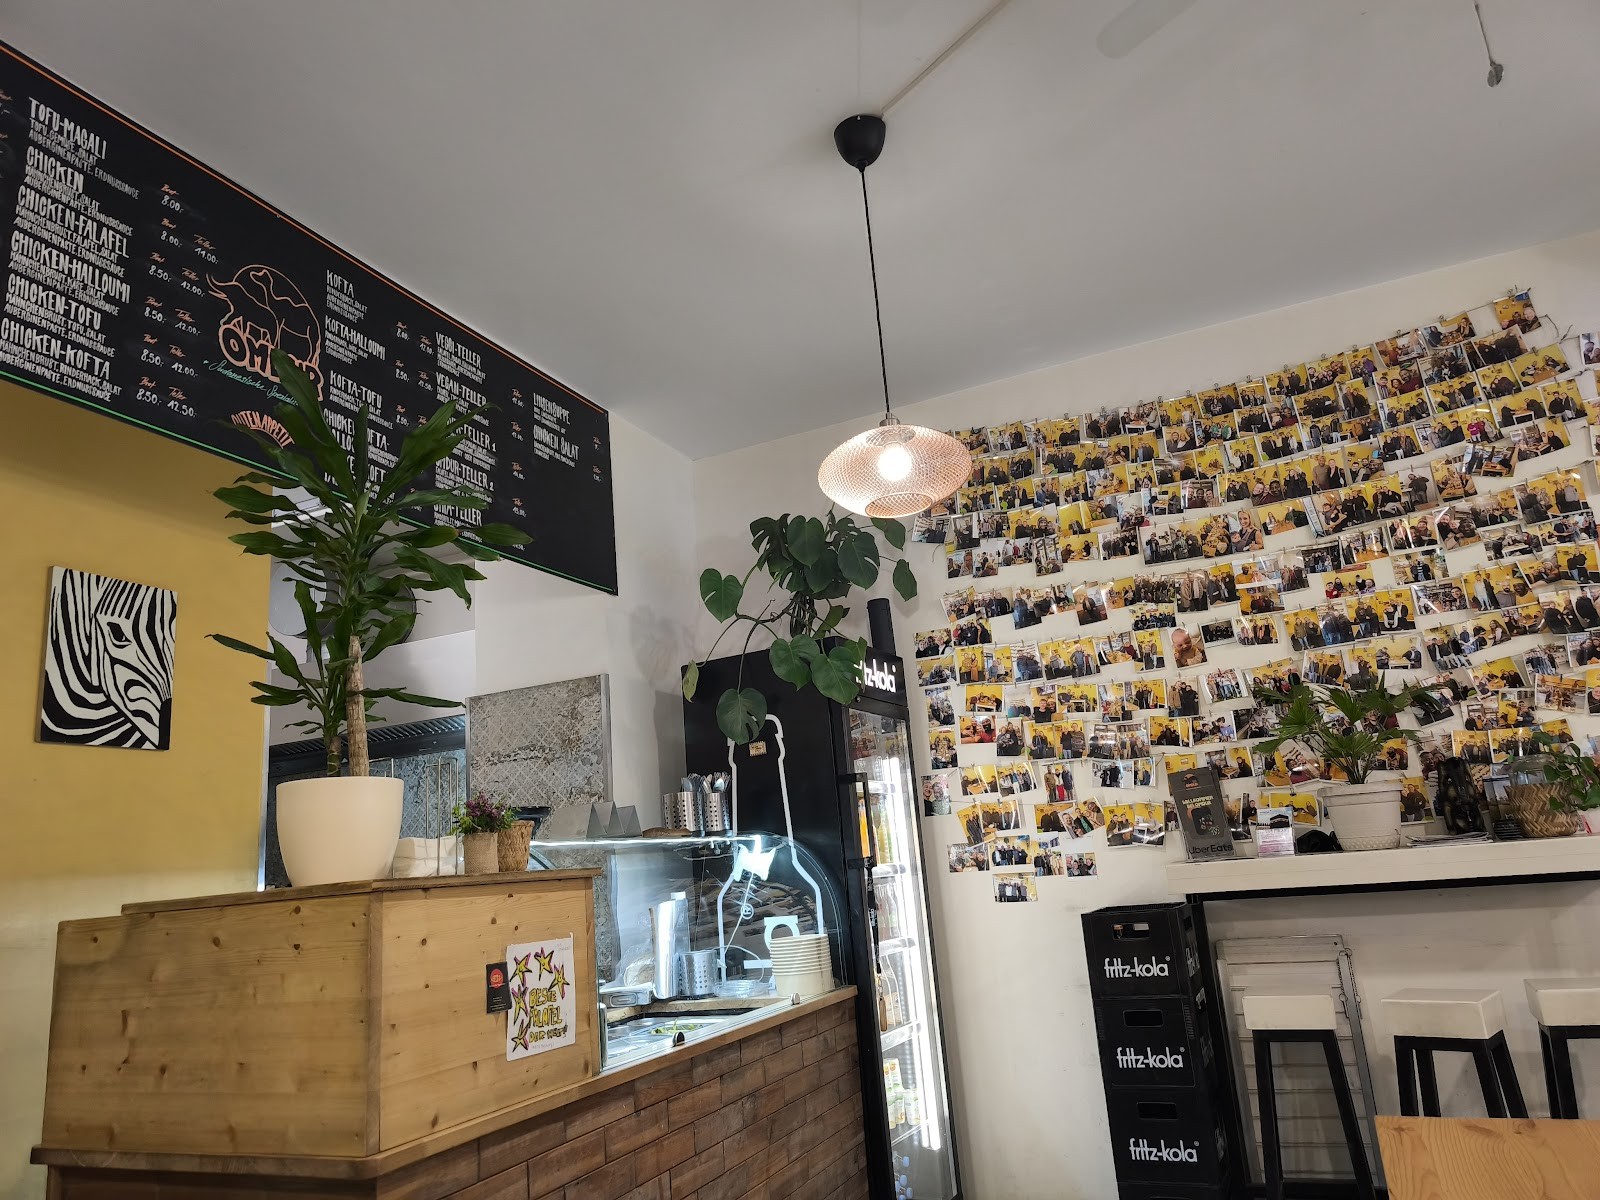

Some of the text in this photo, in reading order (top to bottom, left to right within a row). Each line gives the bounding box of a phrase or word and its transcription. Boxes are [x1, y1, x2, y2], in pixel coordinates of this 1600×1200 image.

[28, 96, 107, 161] TOFU-MAGALI
[26, 146, 84, 194] CHICKEN
[17, 185, 129, 258] CHICKEN-FALAFEL
[11, 230, 131, 304] CHICKEN-HALLOUMI
[326, 269, 355, 299] KOFTA
[8, 273, 101, 330] CHICKEN-TOFU
[0, 317, 110, 381] CHICKEN-KOFTA
[325, 315, 386, 361] KOFTA-HALLOUMI
[436, 331, 481, 370] VEGGI-TELLER
[330, 370, 382, 409] KOFTA-TOFU
[533, 424, 559, 451] CHICKEN
[560, 436, 580, 461] SALAT
